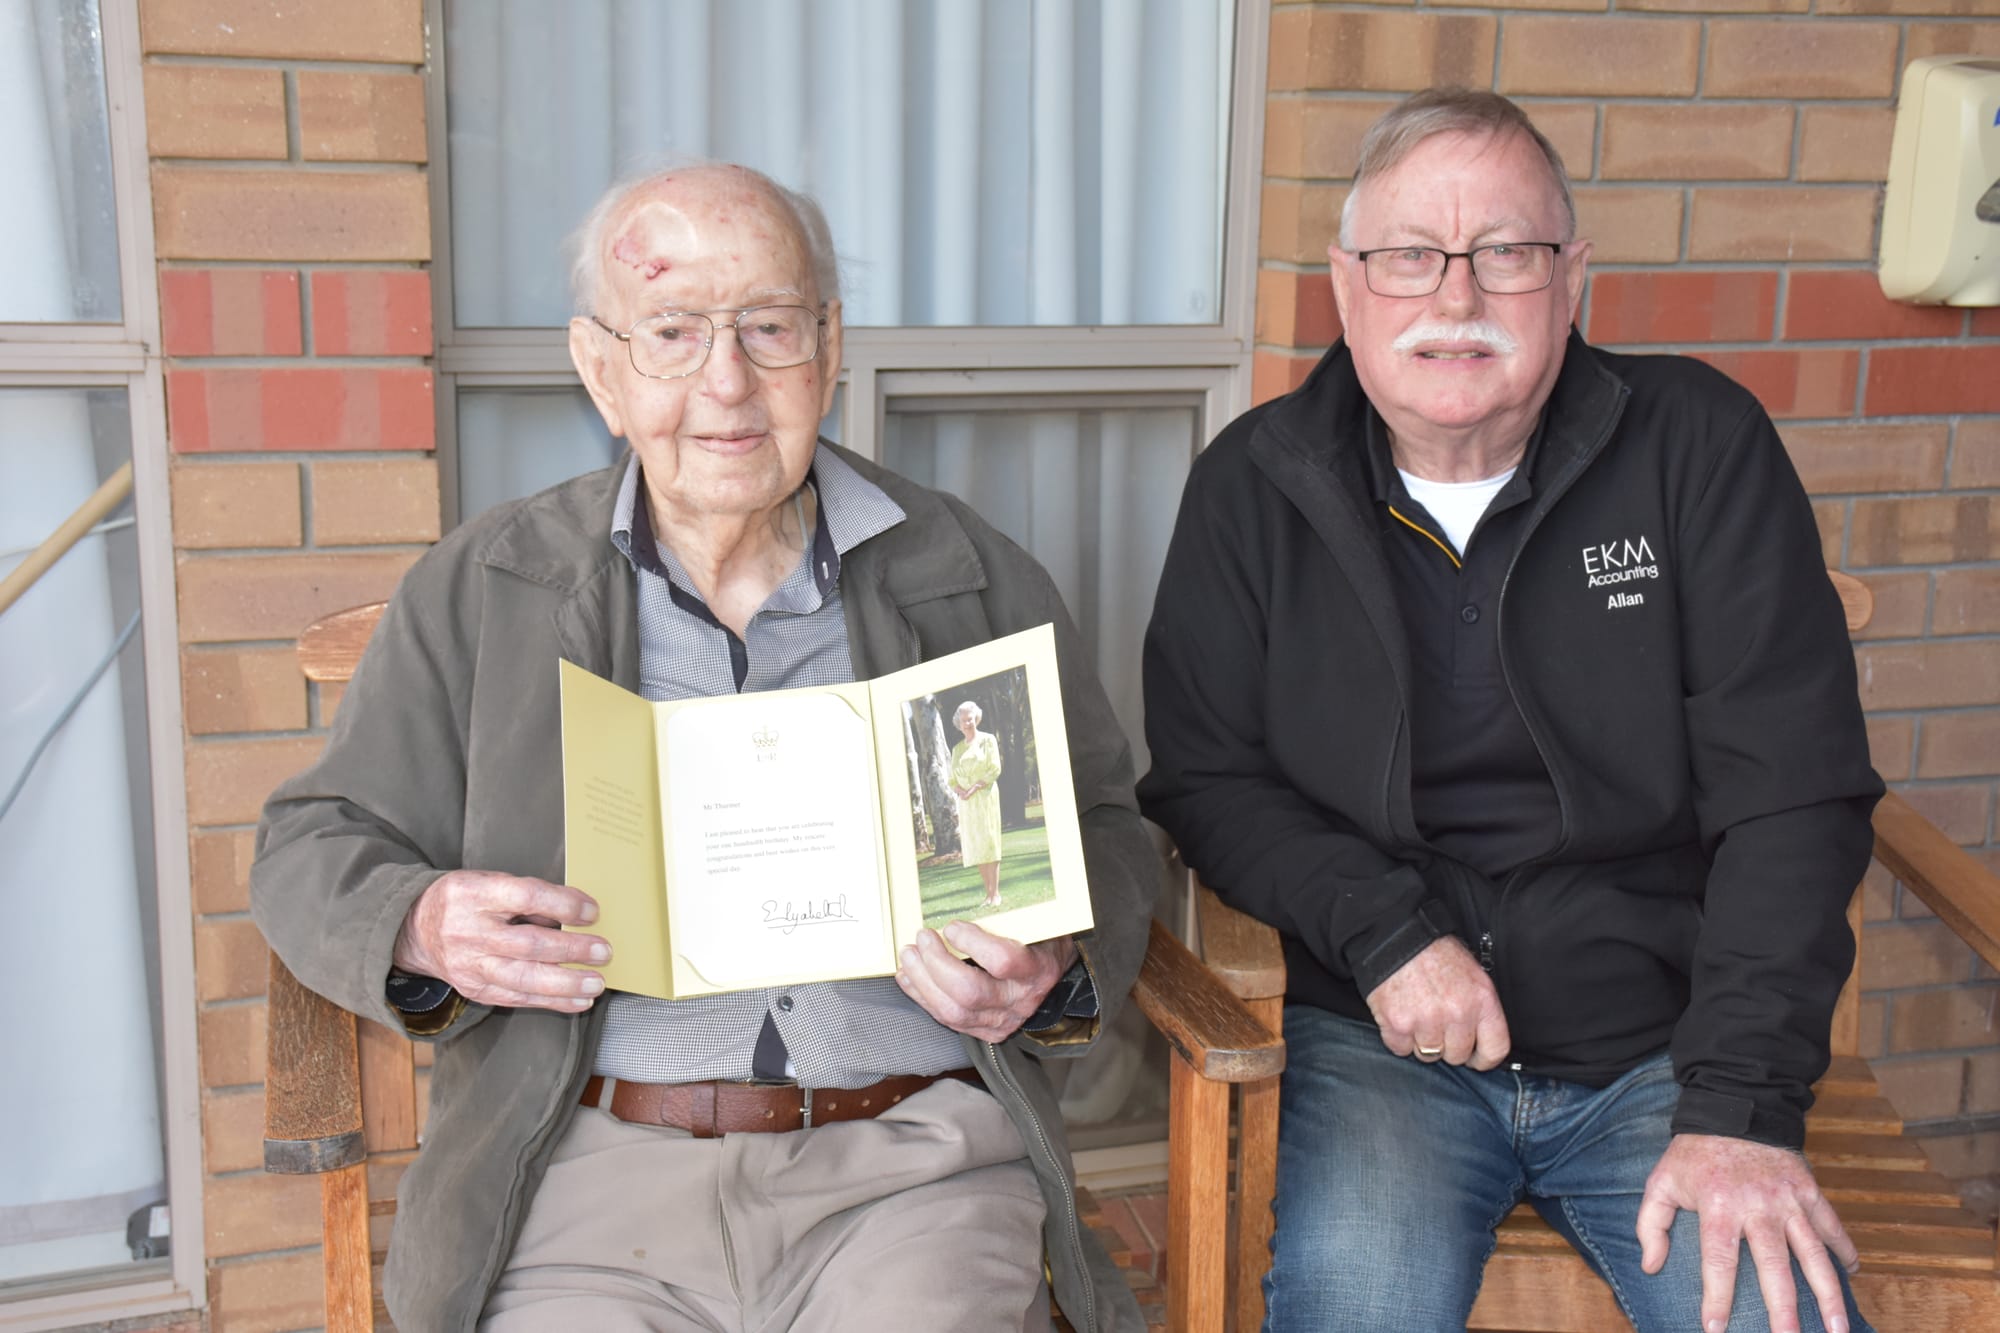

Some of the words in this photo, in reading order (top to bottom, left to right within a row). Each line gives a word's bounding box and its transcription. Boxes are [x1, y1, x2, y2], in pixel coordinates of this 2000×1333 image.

[1582, 535, 1656, 575] EKM
[1588, 564, 1660, 589] Accounting
[1607, 592, 1645, 610] Allan
